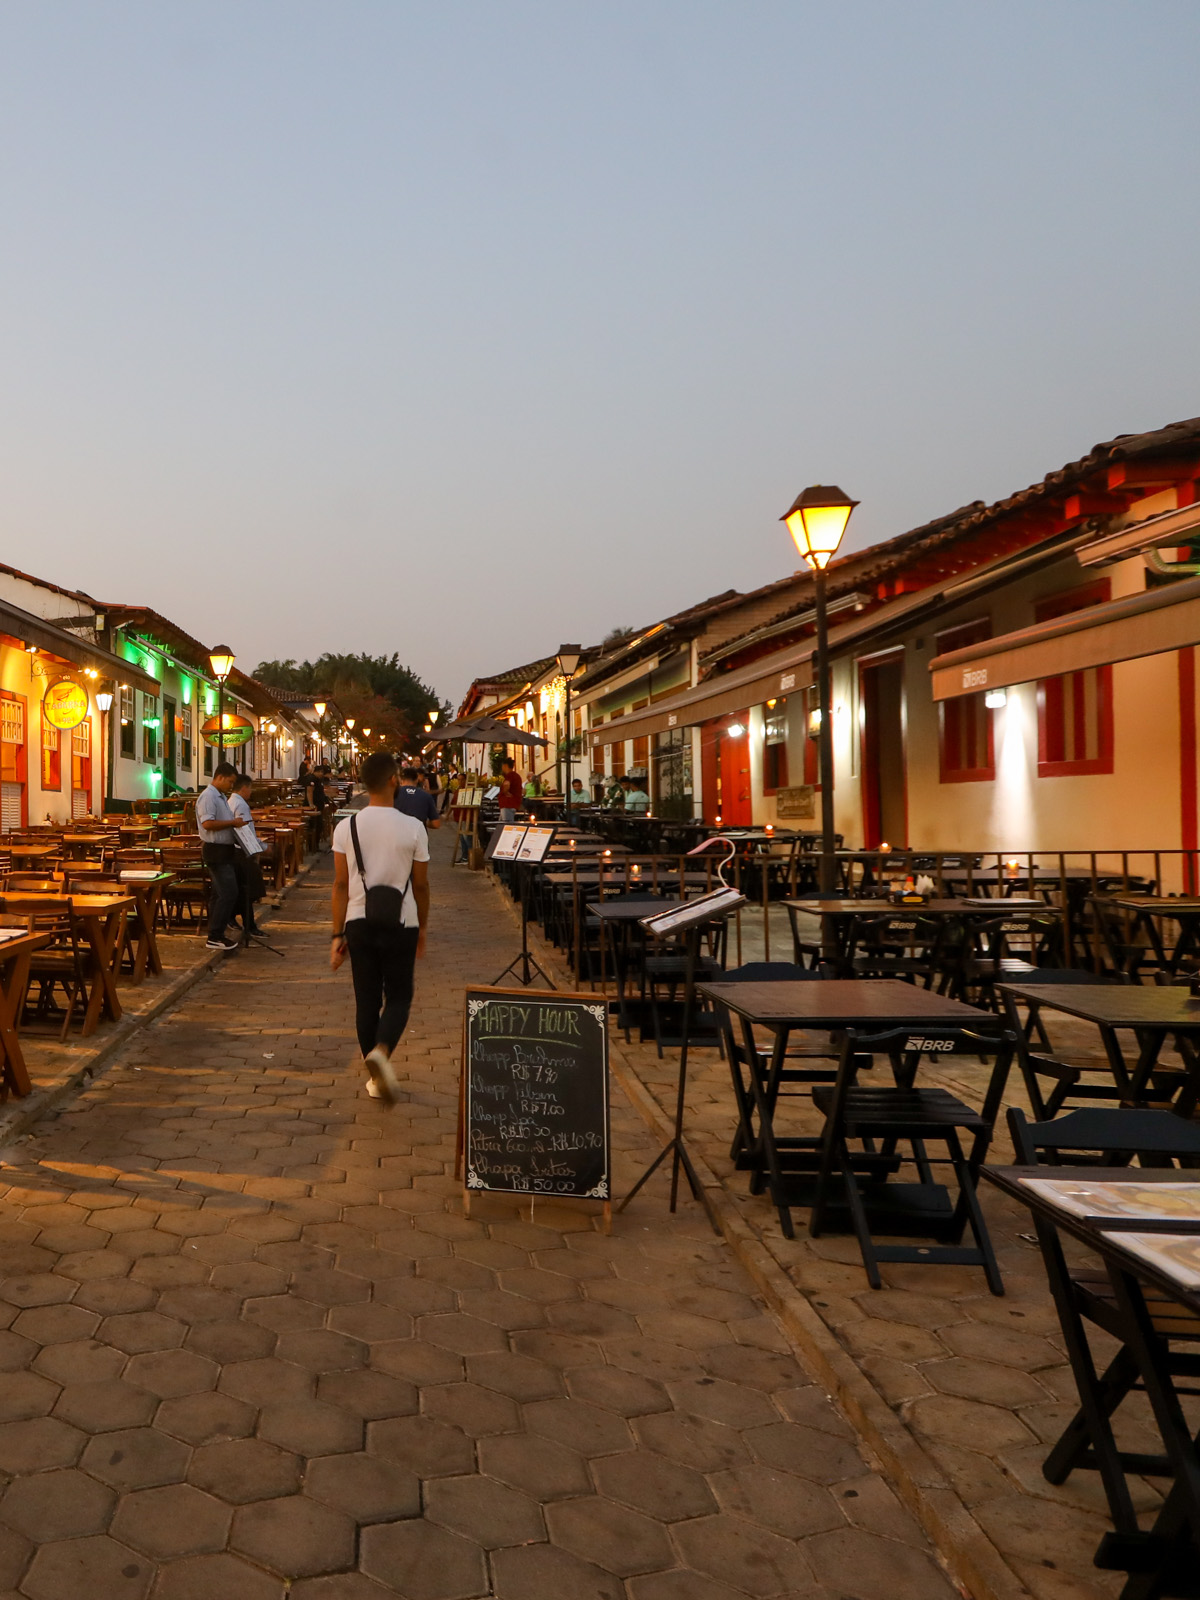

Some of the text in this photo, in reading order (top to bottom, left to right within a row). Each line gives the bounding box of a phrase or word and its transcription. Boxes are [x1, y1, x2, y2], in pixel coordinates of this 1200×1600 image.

[477, 1004, 582, 1036] HAPPY HOUR
[921, 1040, 955, 1051] BRB
